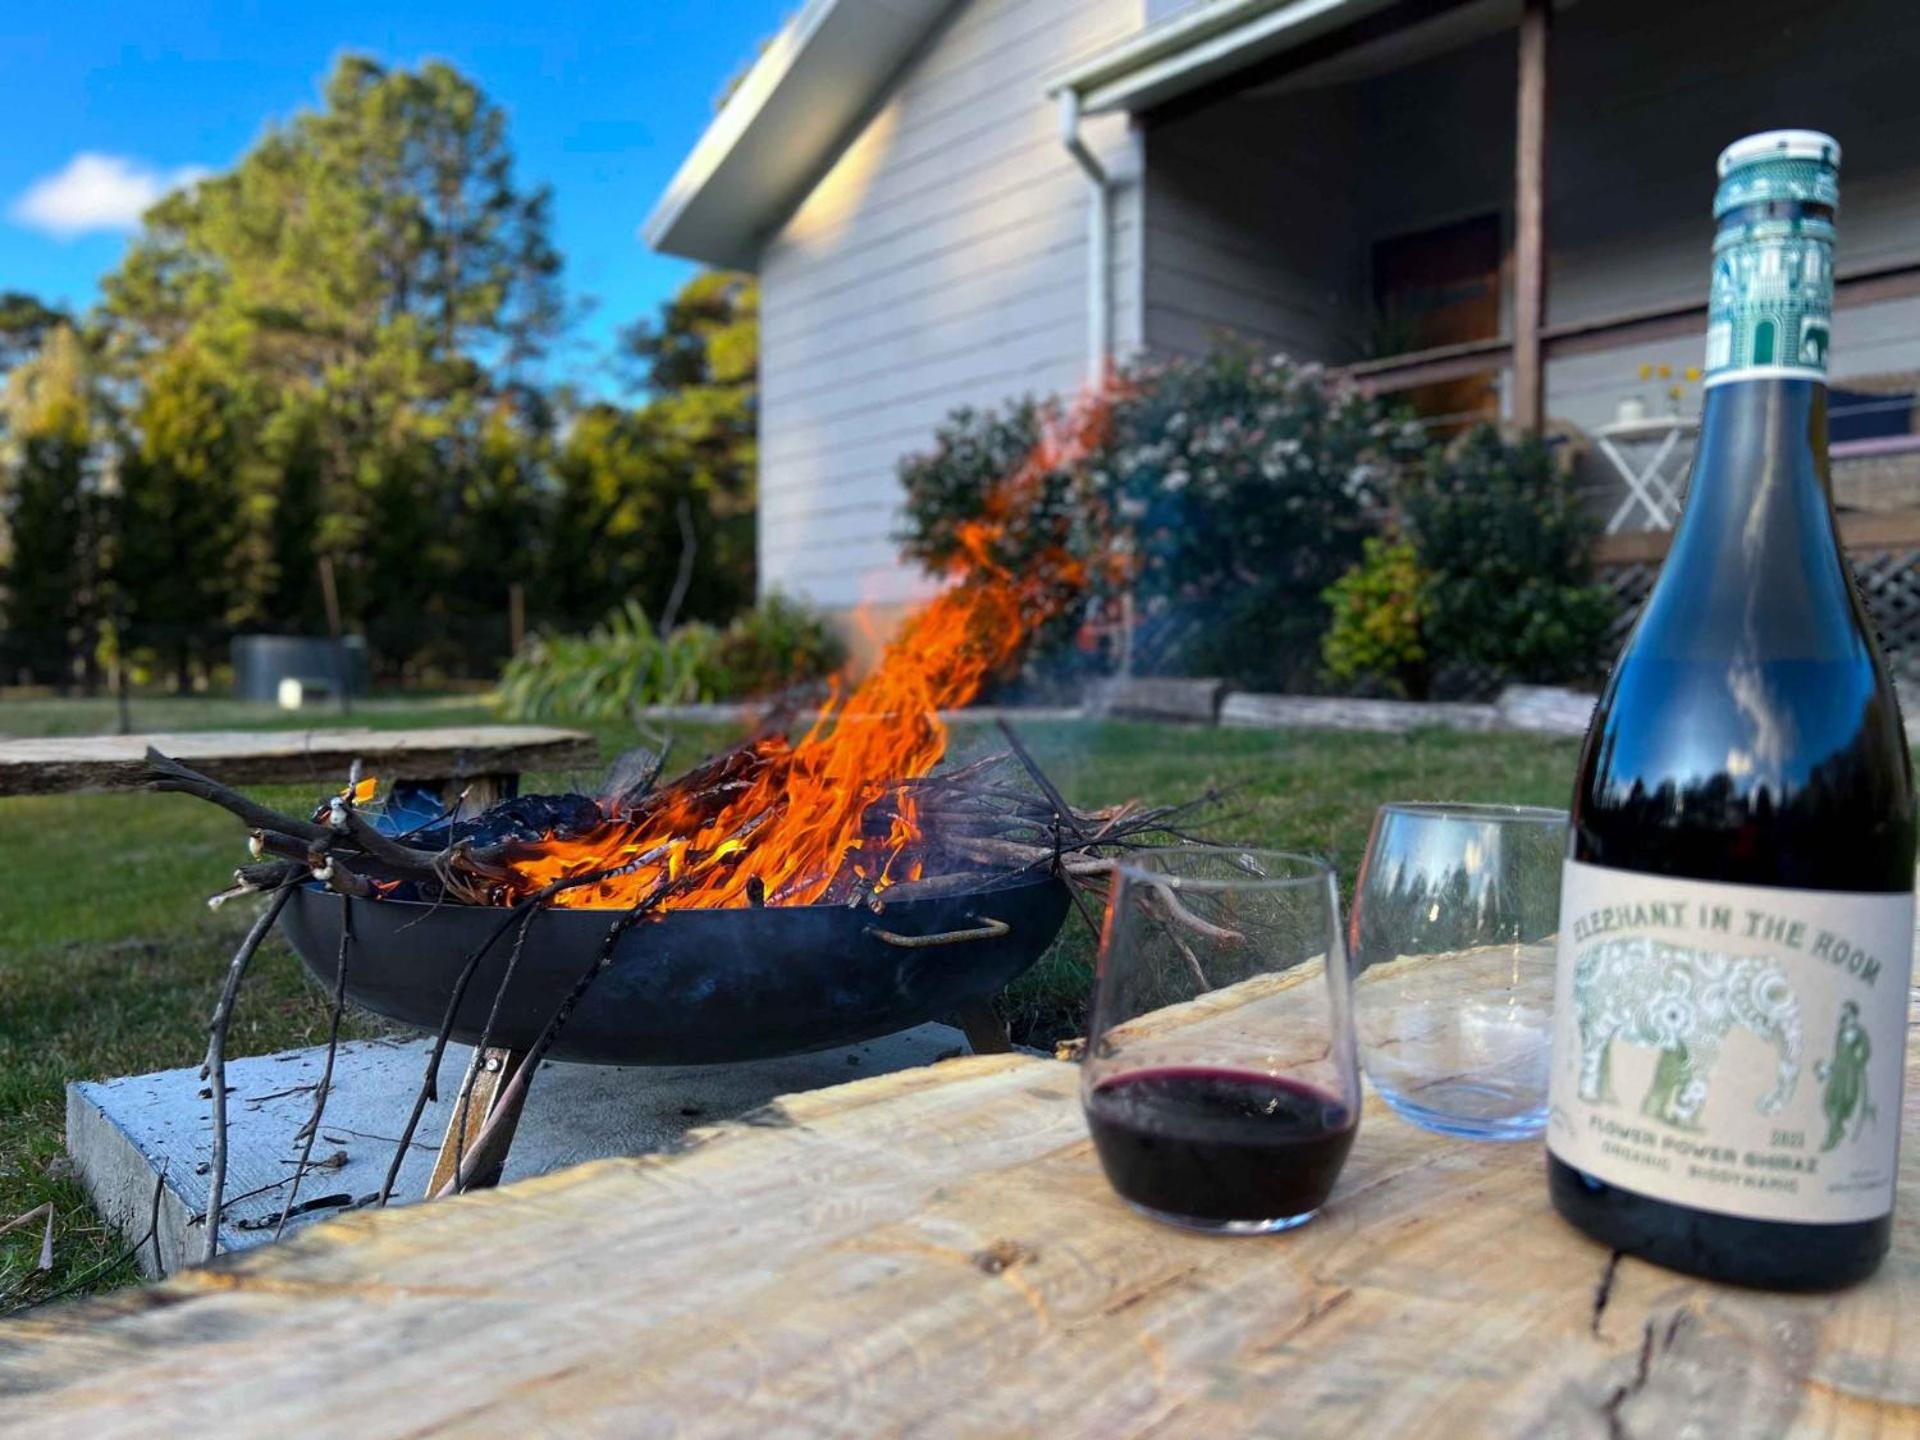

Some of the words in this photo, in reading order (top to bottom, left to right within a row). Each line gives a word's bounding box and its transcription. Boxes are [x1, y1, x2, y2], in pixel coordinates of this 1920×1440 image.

[1573, 902, 1688, 943] ELEPHANT
[1699, 904, 1733, 931] IN
[1744, 910, 1809, 948] THE
[1810, 929, 1883, 987] ROOM
